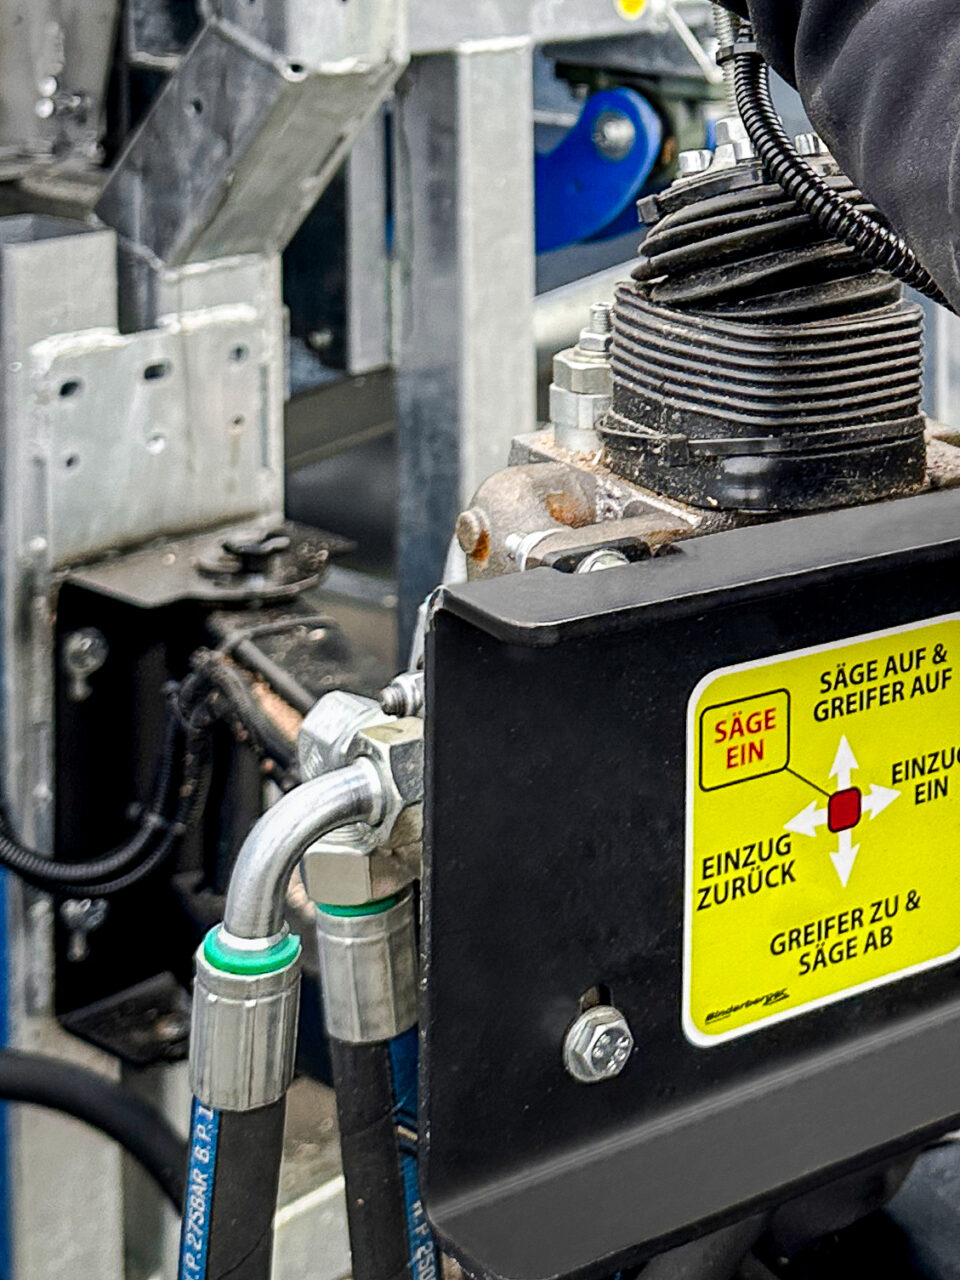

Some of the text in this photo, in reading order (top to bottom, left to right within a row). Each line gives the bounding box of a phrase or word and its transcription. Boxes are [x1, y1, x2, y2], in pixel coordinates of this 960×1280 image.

[820, 643, 947, 694] SÄGE AUF &
[814, 667, 952, 722] GREIFER AUF
[715, 708, 776, 743] SÄGE
[727, 739, 763, 769] EIN
[915, 776, 948, 805] EIN
[703, 833, 791, 880] EINZUG
[697, 860, 795, 911] ZURÜCK
[770, 890, 920, 955] GREIFER ZU &
[797, 926, 892, 976] SÄGE AB
